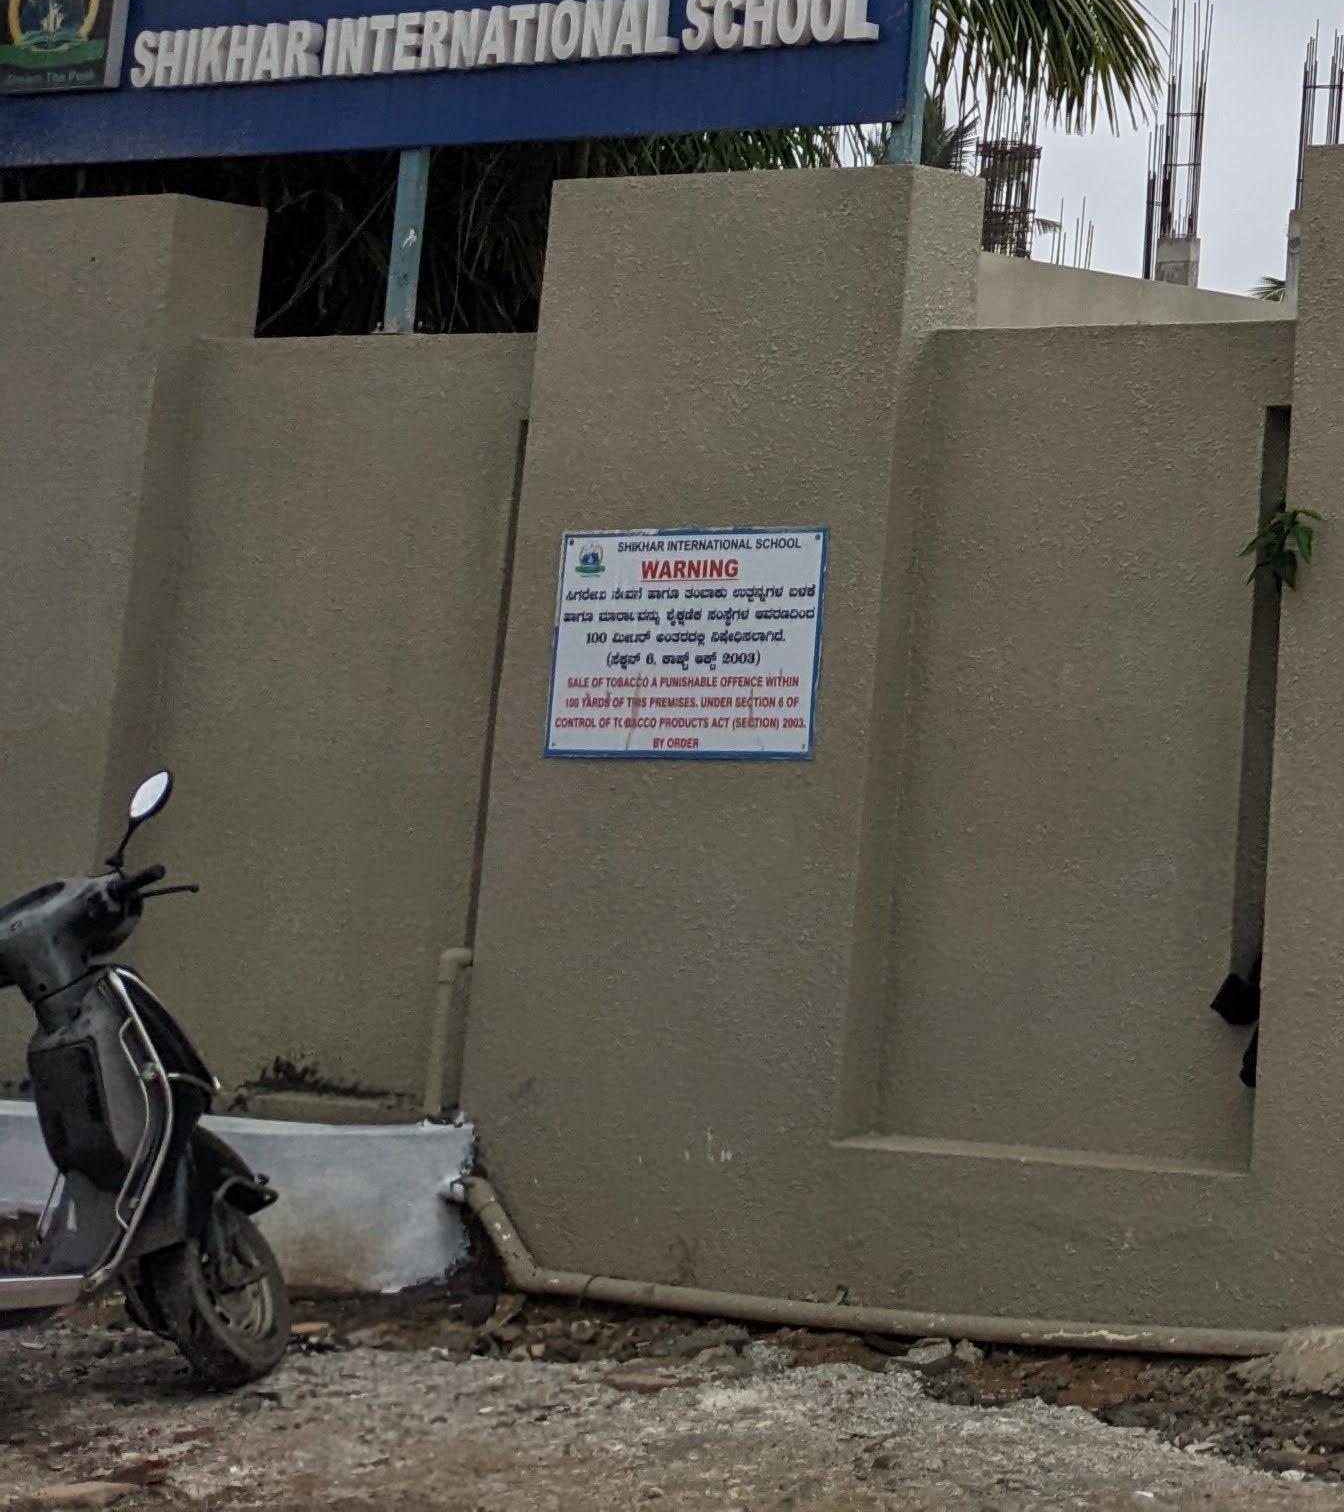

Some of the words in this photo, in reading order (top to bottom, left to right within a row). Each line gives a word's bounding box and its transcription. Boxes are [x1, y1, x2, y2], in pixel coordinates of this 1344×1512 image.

[131, 20, 324, 88] SHIKHAR
[618, 541, 664, 552] SHIKHAR
[667, 539, 752, 551] INTERNATIONAL
[756, 538, 801, 549] SCHOOL
[642, 559, 738, 580] WARNING
[586, 632, 607, 644] 100
[722, 651, 760, 666] 2003)
[568, 677, 589, 688] SALE
[592, 677, 603, 688] OF
[606, 676, 649, 689] TOBACCO
[651, 677, 657, 687] A
[660, 677, 717, 687] PUNISHABLE
[720, 676, 763, 687] OFFENCE
[766, 675, 799, 687] WITHIN
[566, 698, 579, 708] 100
[582, 696, 611, 707] YARDS
[613, 697, 624, 708] OF
[701, 697, 732, 707] UNDER
[735, 695, 775, 709] SECTION
[778, 697, 783, 707] 6
[786, 697, 799, 707] OF
[555, 718, 596, 728] CONTROL
[599, 717, 611, 728] OF
[659, 717, 709, 728] PRODUCTS
[711, 717, 729, 728] ACT
[733, 716, 779, 730] (SECTION)
[653, 738, 664, 748] BY
[667, 738, 699, 748] ORDER
